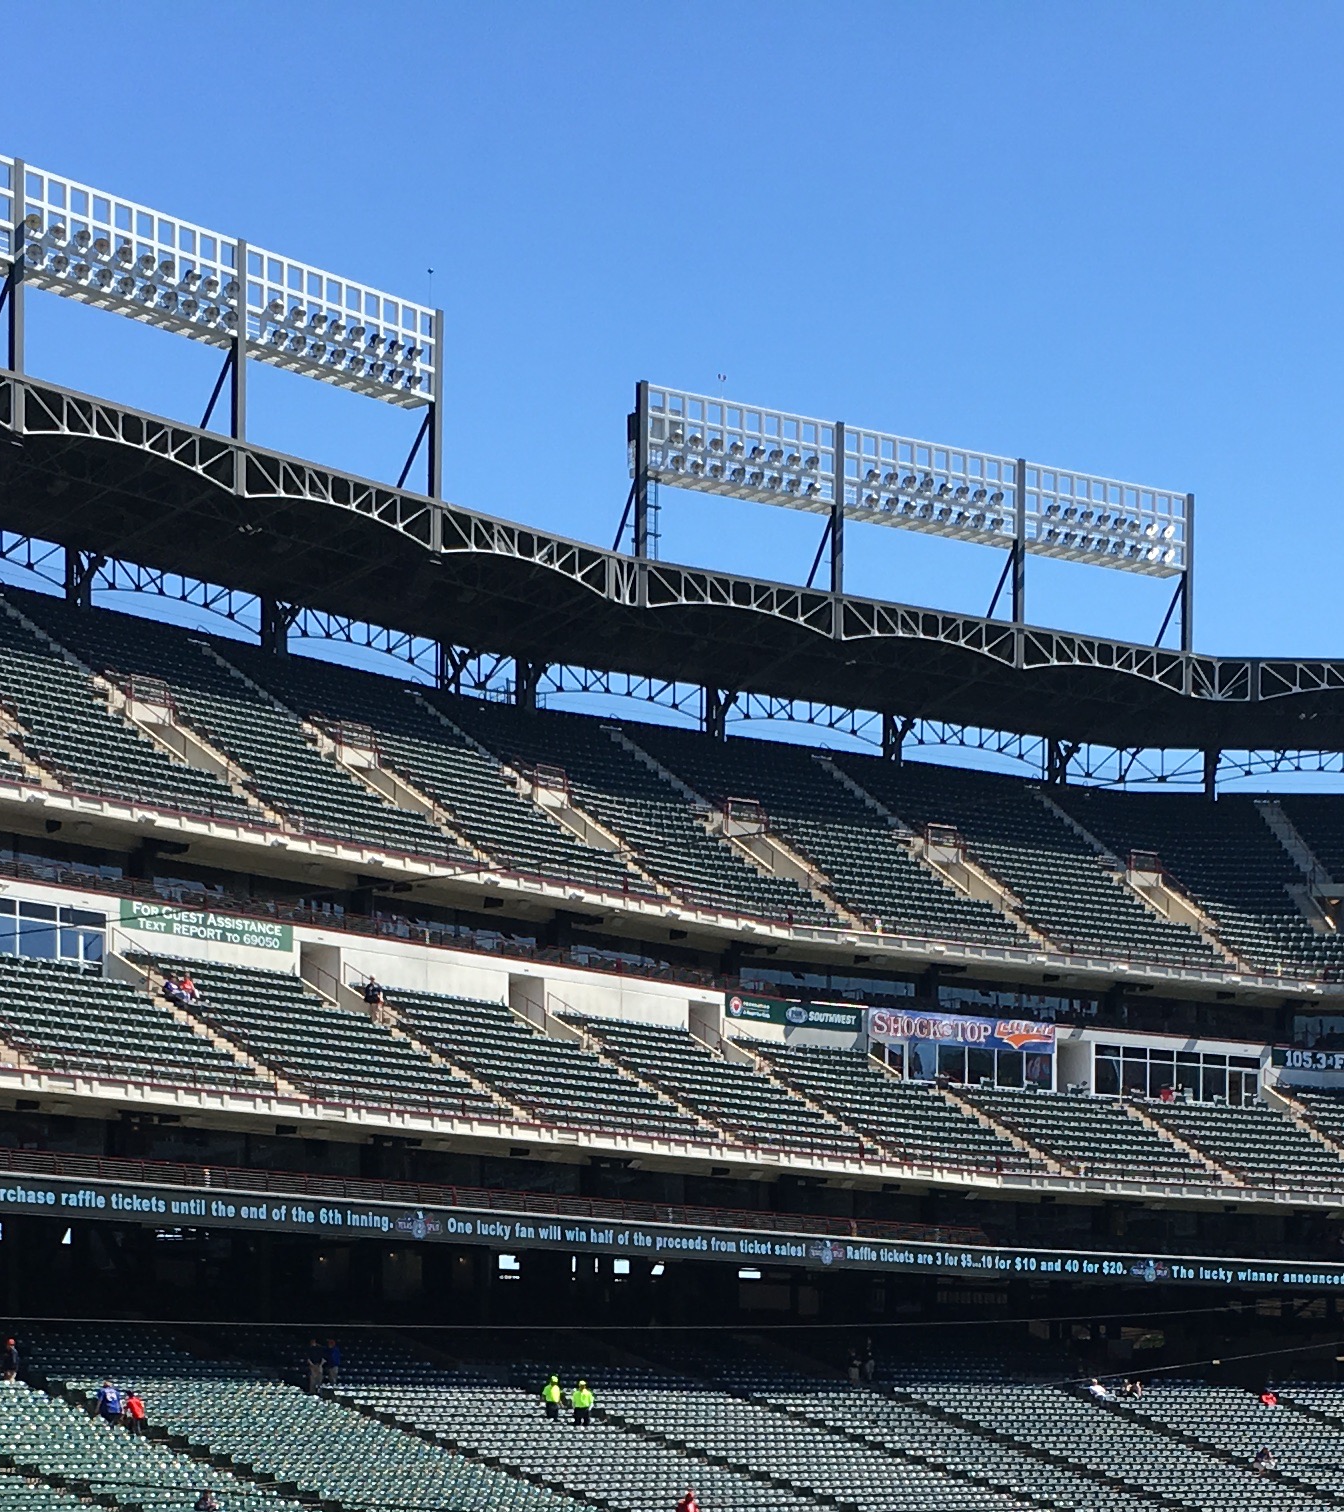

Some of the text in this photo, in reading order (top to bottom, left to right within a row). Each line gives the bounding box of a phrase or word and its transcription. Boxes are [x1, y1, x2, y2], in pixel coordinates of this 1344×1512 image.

[132, 901, 283, 938] FOR GUEST ASSISTANCE
[138, 916, 169, 932] TEXT
[172, 922, 222, 941] REPORT
[243, 930, 280, 950] 69050
[808, 1011, 857, 1026] SOUTHWEST
[873, 1012, 942, 1038] SHOCK
[954, 1021, 992, 1043] TOP
[1285, 1049, 1327, 1069] 105.3
[60, 1190, 106, 1209] raffle
[110, 1192, 166, 1213] tickets
[171, 1197, 207, 1217] until
[211, 1200, 236, 1217] the
[240, 1203, 267, 1219] end
[271, 1204, 287, 1221] of
[291, 1206, 315, 1224] the
[319, 1207, 343, 1226] 6th
[346, 1209, 394, 1232] inning.
[447, 1217, 473, 1235] One
[476, 1220, 512, 1241] lucky
[515, 1224, 536, 1239] fan
[538, 1225, 562, 1241] will
[565, 1227, 587, 1243] win
[590, 1228, 614, 1245] half
[617, 1230, 631, 1246] of
[632, 1231, 652, 1247] the
[656, 1234, 709, 1251] proceeds
[710, 1236, 737, 1253] from
[739, 1239, 772, 1255] ticket
[846, 1245, 877, 1260] Raffle
[879, 1247, 914, 1264] tickets
[917, 1251, 934, 1265] are
[936, 1251, 943, 1265] 3
[944, 1252, 958, 1266] for
[995, 1255, 1013, 1270] for
[1014, 1256, 1037, 1271] $10
[1040, 1258, 1063, 1273] and
[1064, 1258, 1080, 1273] 40
[1082, 1259, 1100, 1273] for
[1102, 1260, 1128, 1275] $20.
[1171, 1265, 1195, 1279] The
[1199, 1267, 1233, 1283] lucky
[1237, 1270, 1279, 1283] winner
